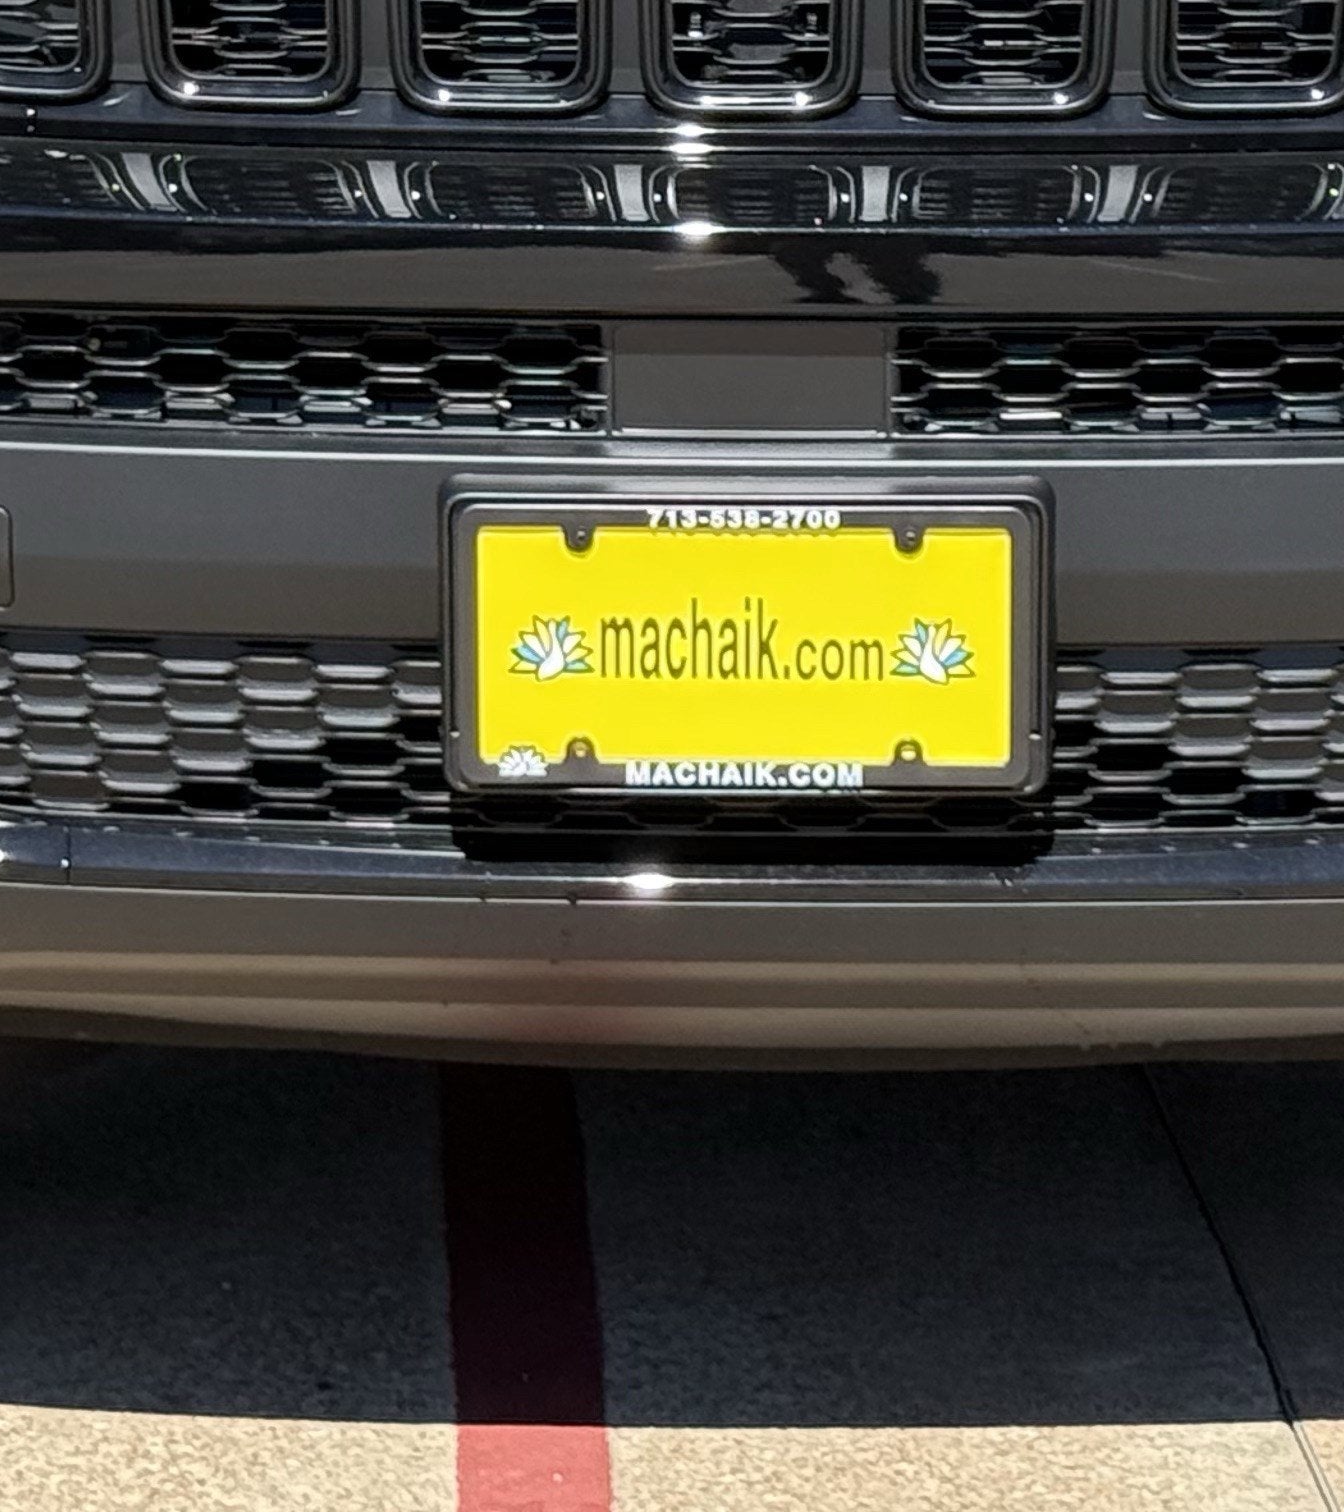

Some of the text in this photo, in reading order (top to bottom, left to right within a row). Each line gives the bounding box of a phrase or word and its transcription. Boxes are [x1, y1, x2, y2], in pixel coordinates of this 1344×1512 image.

[647, 508, 842, 530] 713-538-2700
[600, 596, 885, 681] machaik.com
[625, 761, 864, 787] MACHAIK.COM
